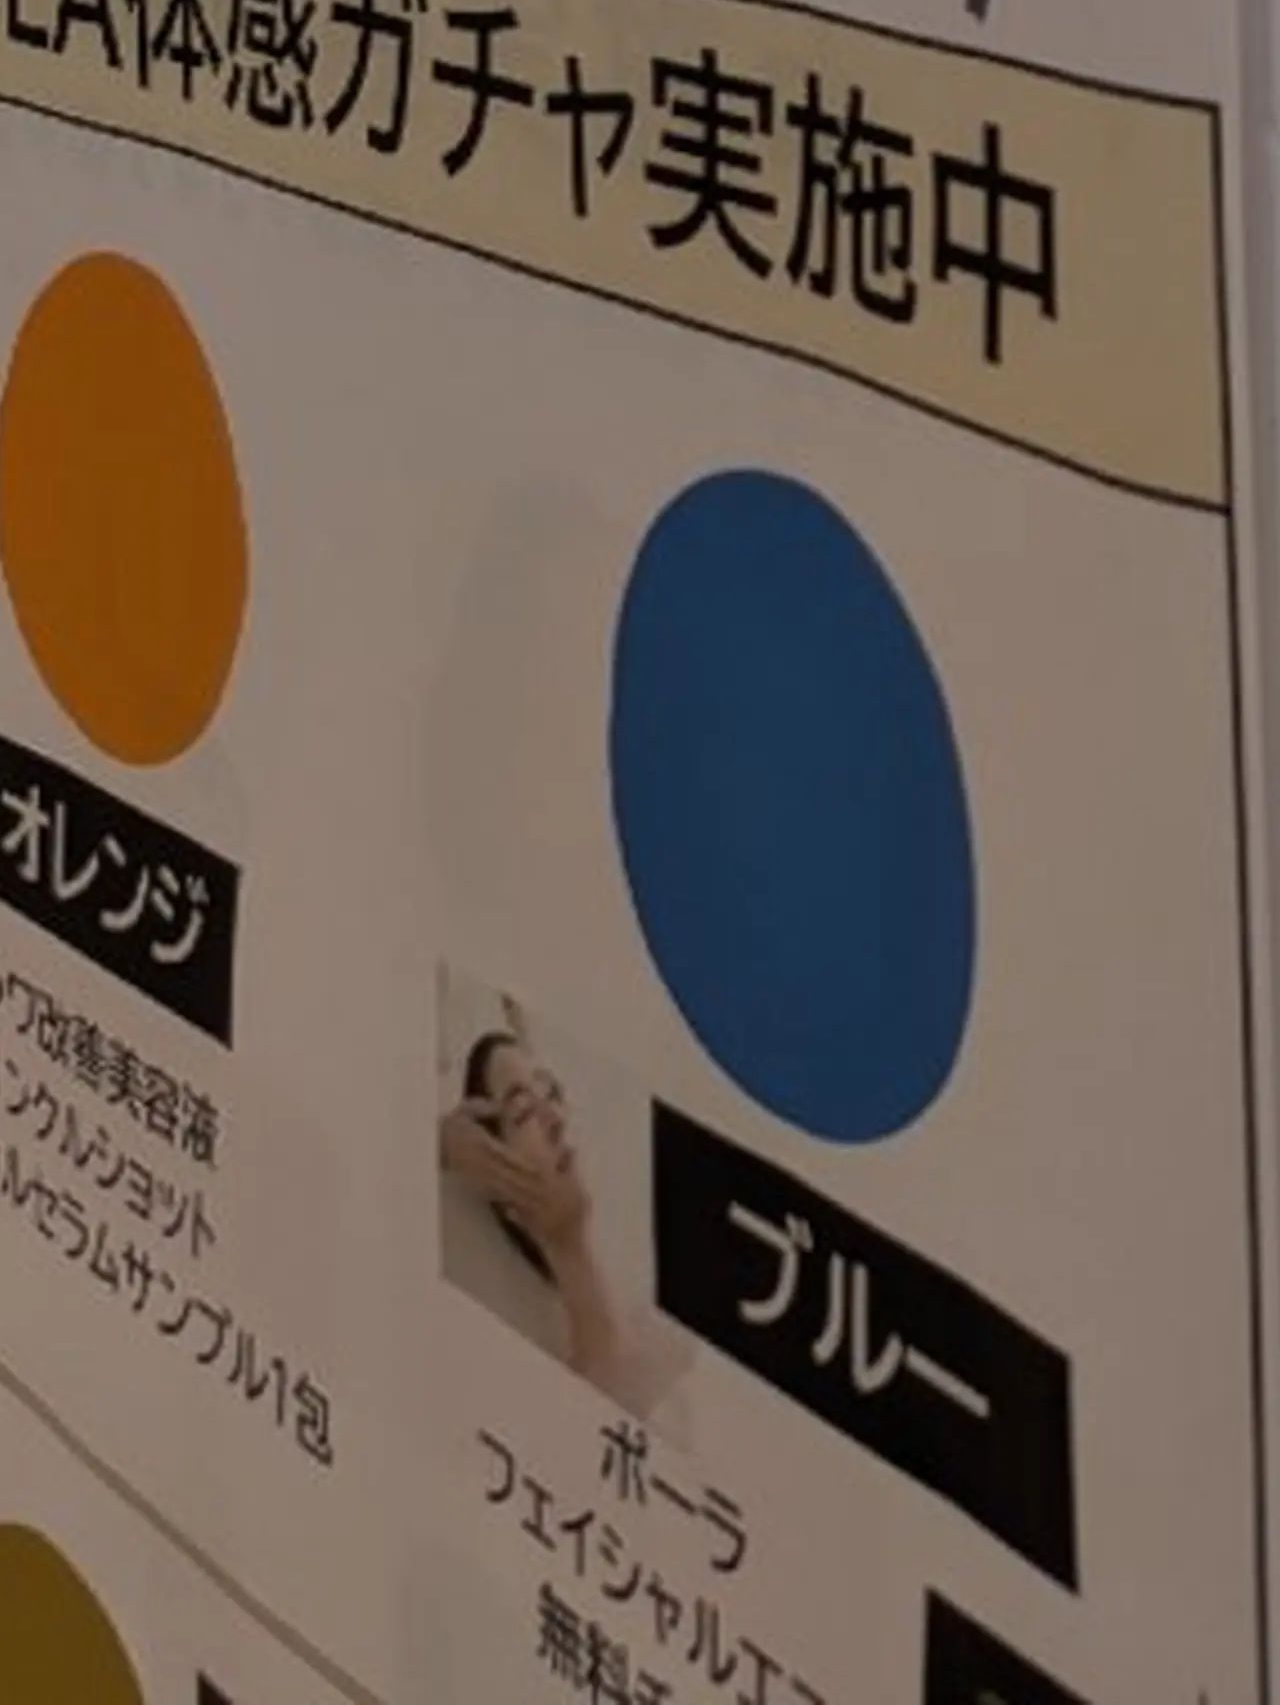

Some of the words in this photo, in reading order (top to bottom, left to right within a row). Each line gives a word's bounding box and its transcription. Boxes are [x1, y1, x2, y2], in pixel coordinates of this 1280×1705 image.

[0, 784, 209, 965] オレンジ
[729, 1201, 990, 1420] ブルー
[478, 1428, 828, 1705] フェイシャルエ
